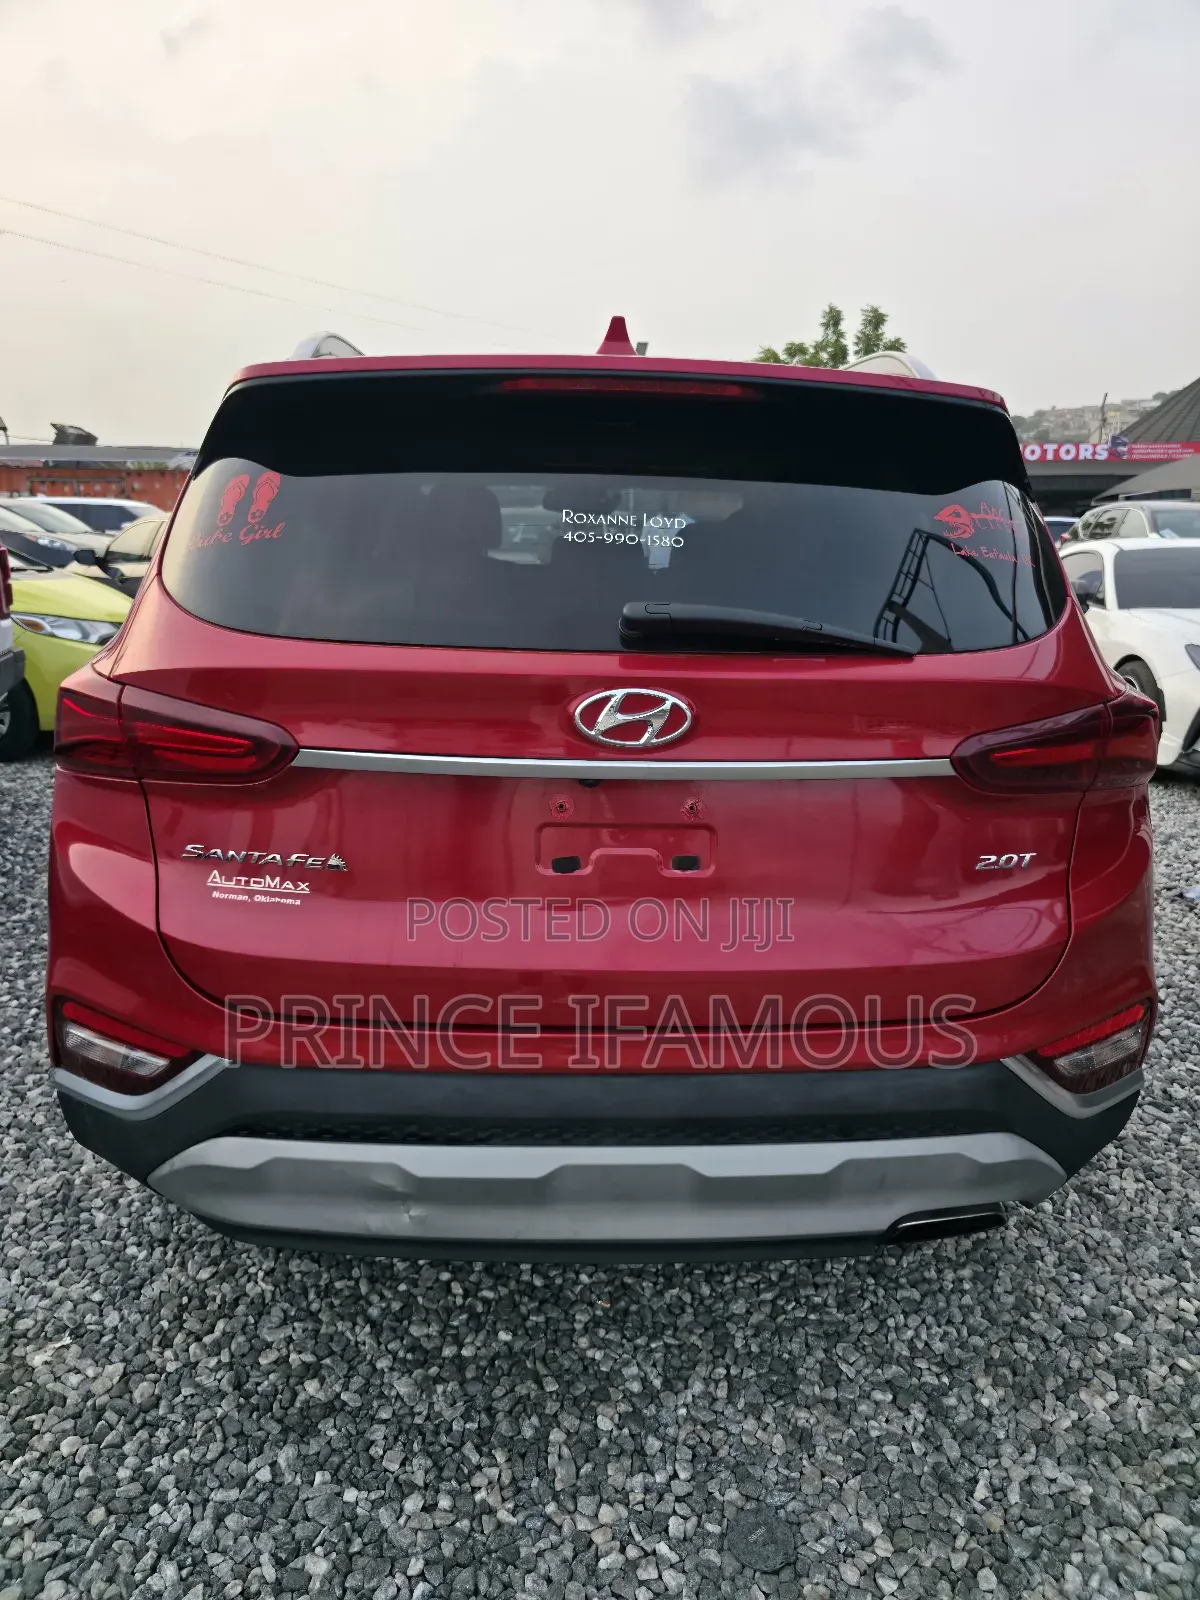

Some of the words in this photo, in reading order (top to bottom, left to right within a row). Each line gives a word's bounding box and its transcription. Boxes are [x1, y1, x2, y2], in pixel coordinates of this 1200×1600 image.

[1020, 443, 1108, 461] OTORS
[239, 522, 286, 546] Girl
[563, 531, 684, 548] 405-990-1580
[950, 543, 978, 557] Lake
[212, 890, 251, 902] Norman,
[254, 894, 301, 905] Oklahoma
